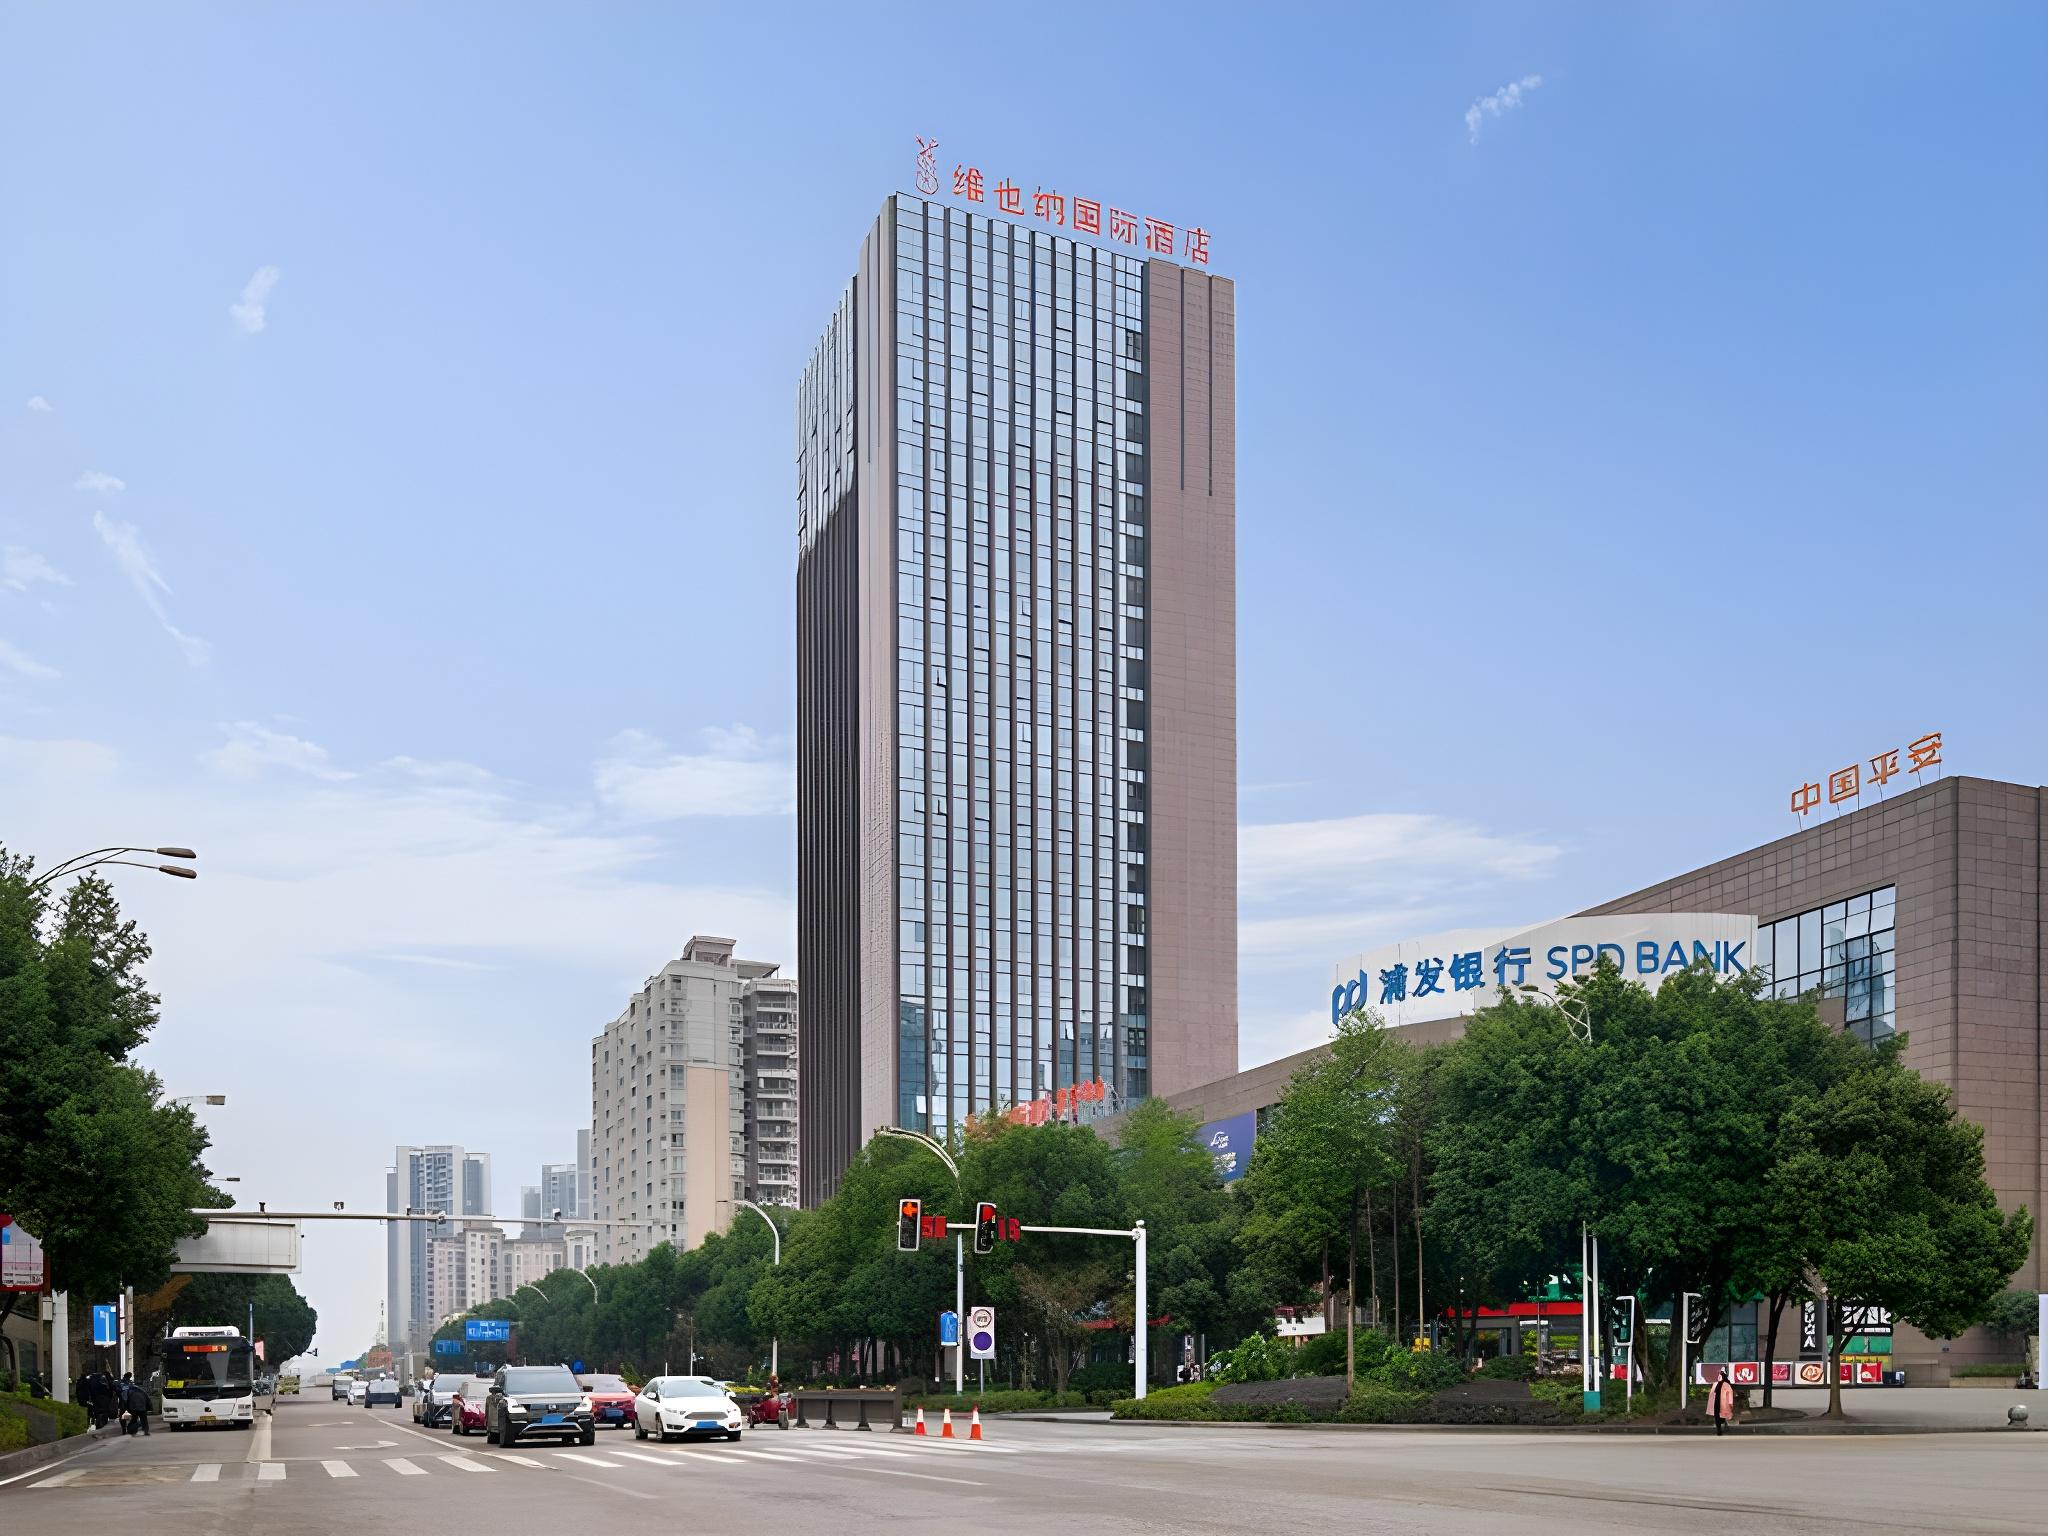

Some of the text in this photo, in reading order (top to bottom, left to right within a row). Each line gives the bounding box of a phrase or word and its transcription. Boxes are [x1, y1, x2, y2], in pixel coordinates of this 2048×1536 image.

[952, 163, 1211, 265] 维也纳国际酒店
[1791, 732, 1942, 815] 中国平安
[1379, 944, 1532, 1005] 浦发银行
[1546, 940, 1747, 980] SPD BANK
